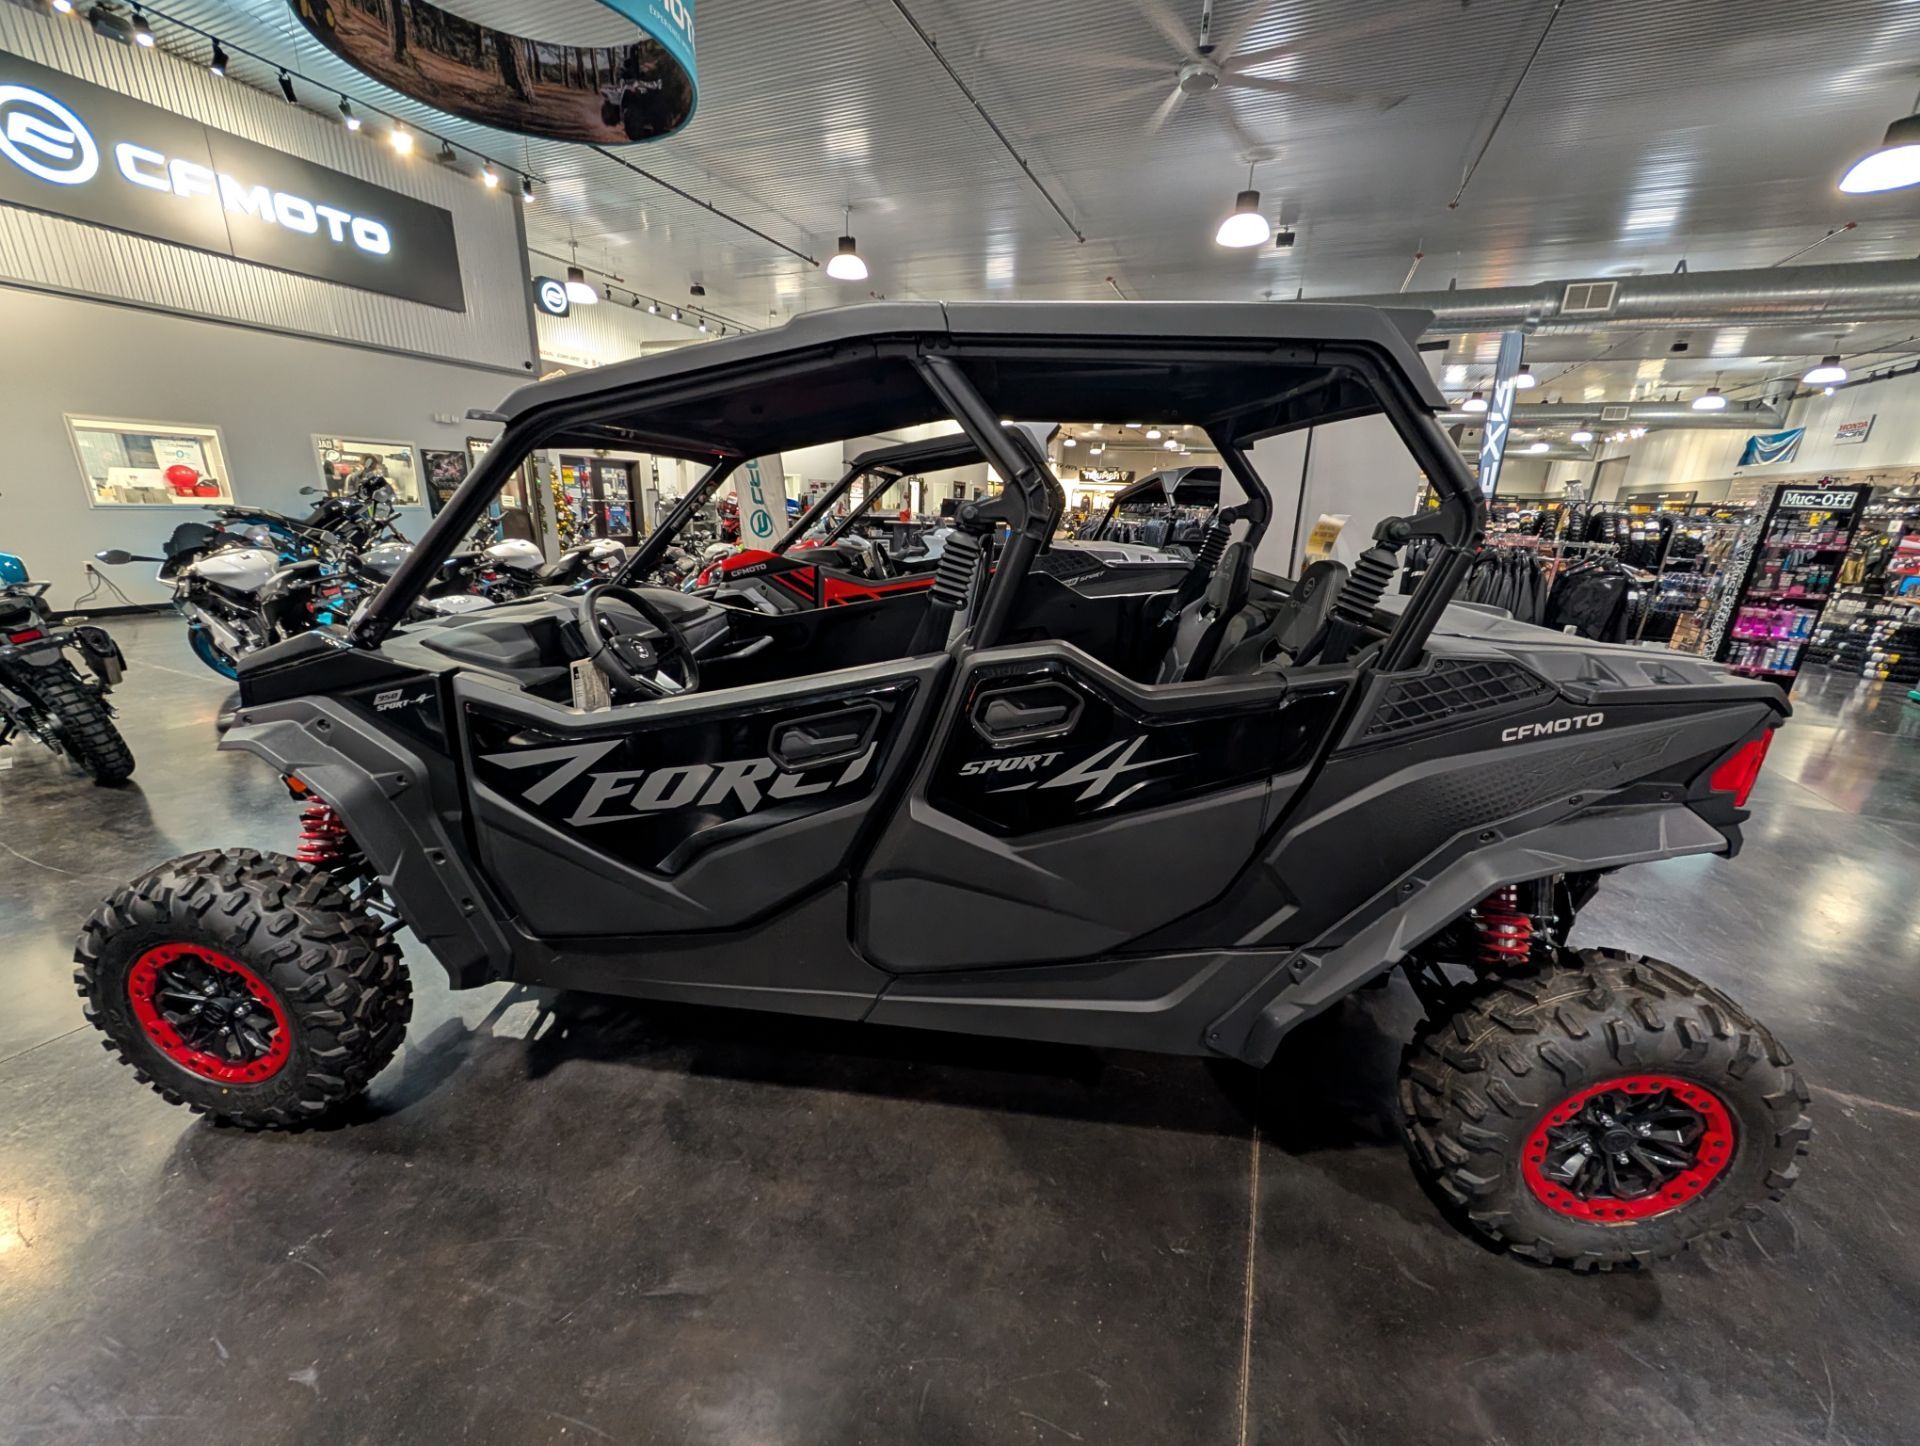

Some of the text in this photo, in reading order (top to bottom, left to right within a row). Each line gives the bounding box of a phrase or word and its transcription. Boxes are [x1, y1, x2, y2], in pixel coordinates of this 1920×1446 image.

[114, 142, 391, 255] CFMOTO
[1783, 493, 1854, 506] Muc-Off
[731, 563, 767, 577] CFMOTO
[1501, 712, 1604, 742] CFMOTO
[958, 734, 1200, 802] SPORT 4
